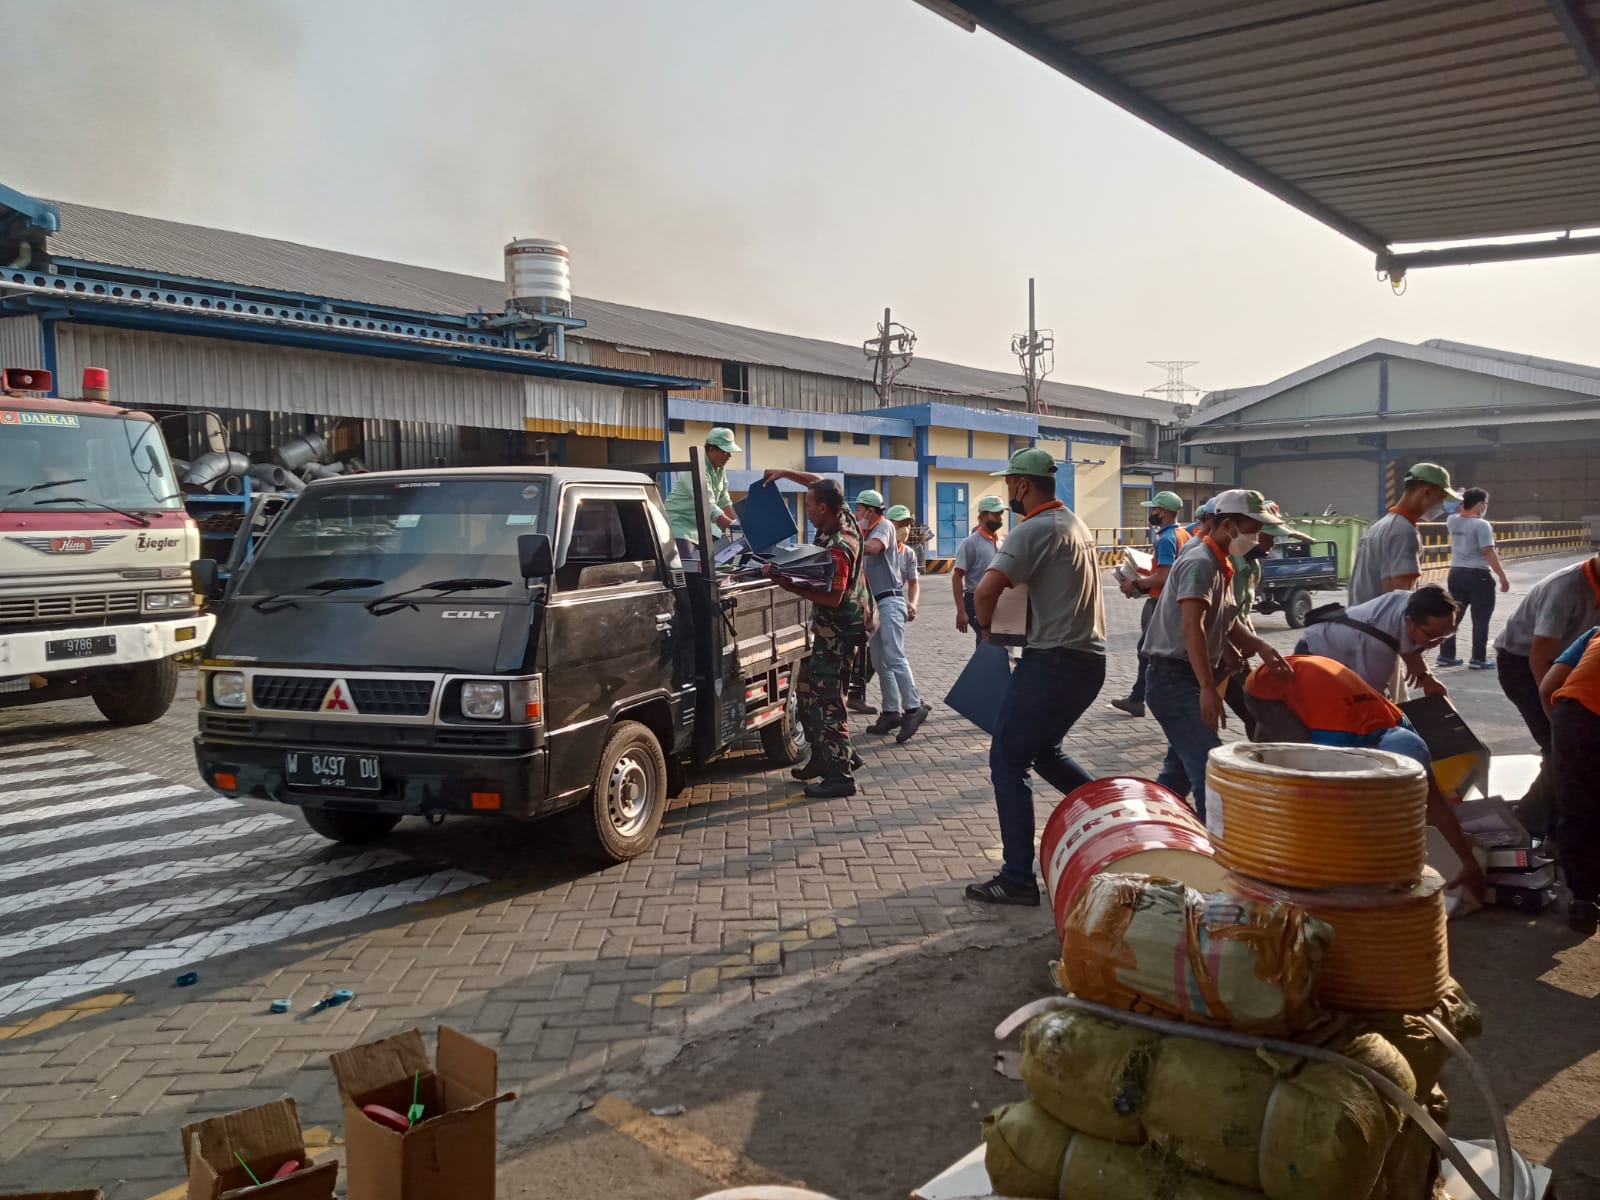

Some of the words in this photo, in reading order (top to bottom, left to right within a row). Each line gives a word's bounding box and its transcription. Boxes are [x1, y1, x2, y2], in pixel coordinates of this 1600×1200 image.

[21, 413, 77, 426] DAMKAR
[59, 539, 86, 551] Hino
[136, 533, 181, 552] Ziegler
[441, 610, 501, 619] COLT
[48, 641, 56, 654] L
[67, 638, 93, 652] 9786
[287, 753, 298, 773] W
[312, 755, 346, 776] 8497
[360, 758, 379, 778] DU
